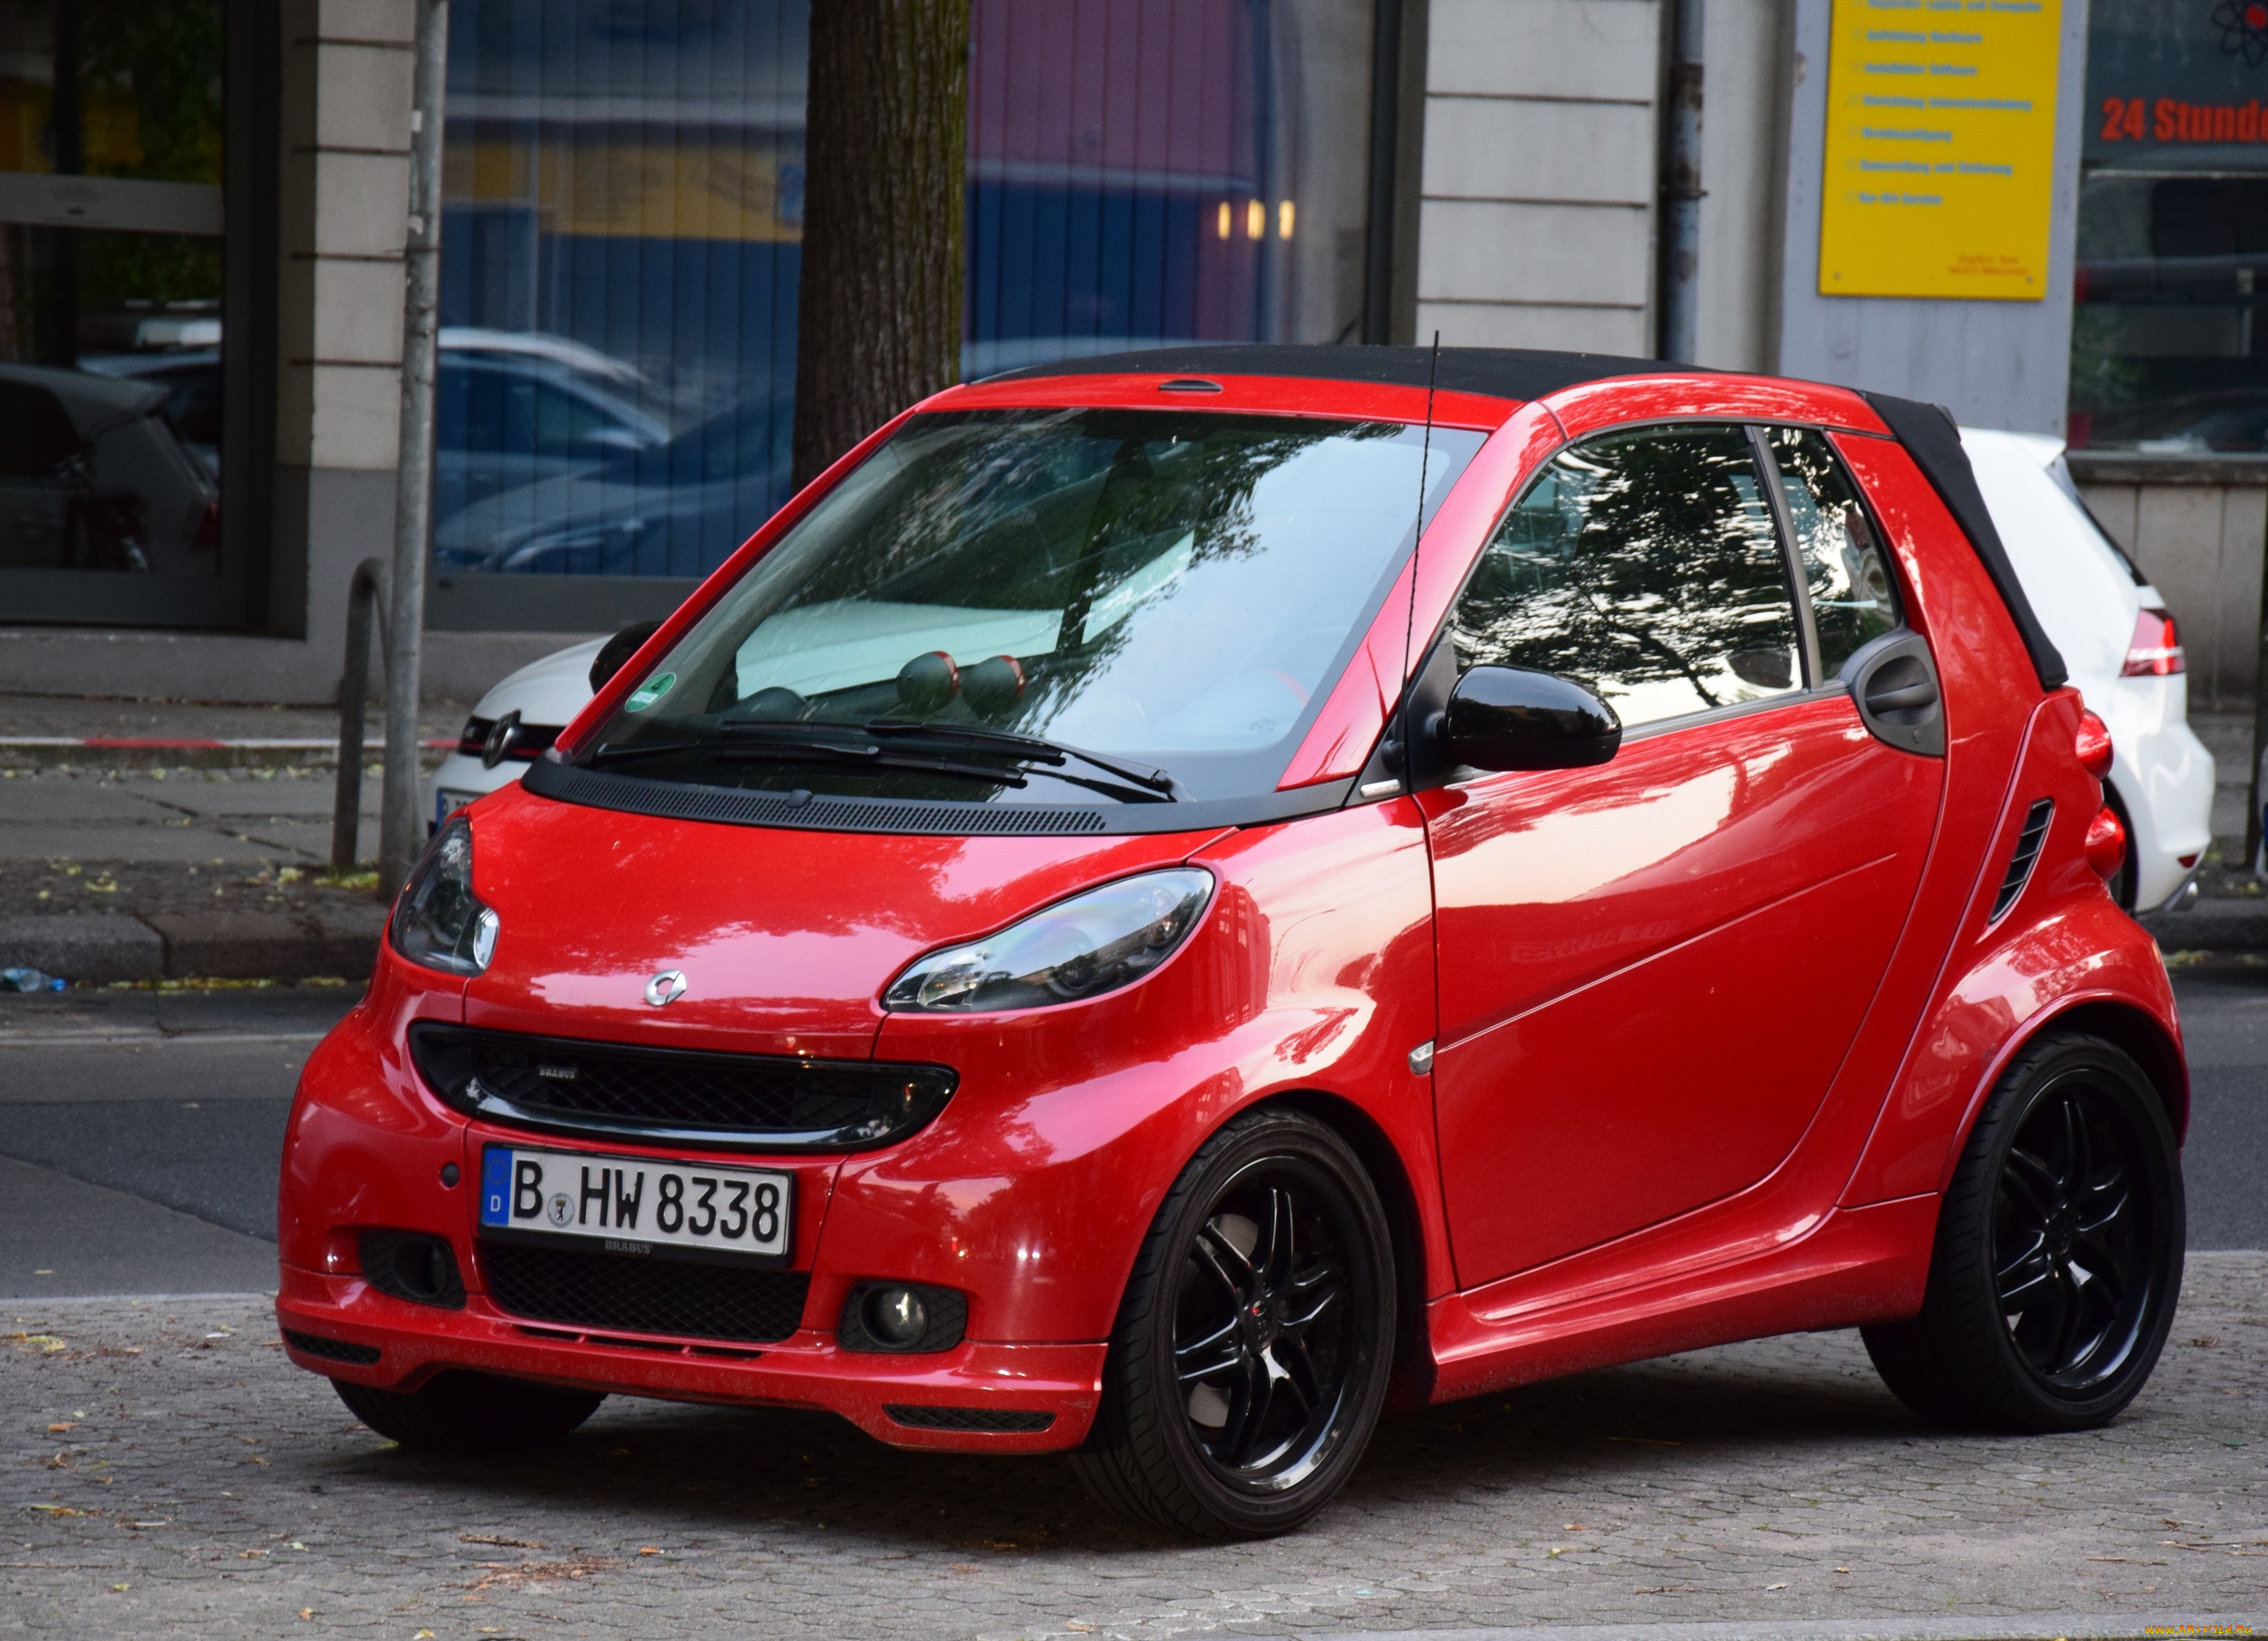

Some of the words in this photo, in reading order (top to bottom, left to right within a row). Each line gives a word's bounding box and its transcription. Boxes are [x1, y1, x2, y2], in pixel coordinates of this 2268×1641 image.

[2101, 97, 2145, 141] 24
[650, 674, 670, 693] 4
[539, 1067, 575, 1079] BRABUS
[490, 1195, 501, 1212] D
[513, 1159, 543, 1219] B
[578, 1165, 644, 1229] HW
[656, 1172, 780, 1243] 8338
[605, 1240, 652, 1255] BRABUS
